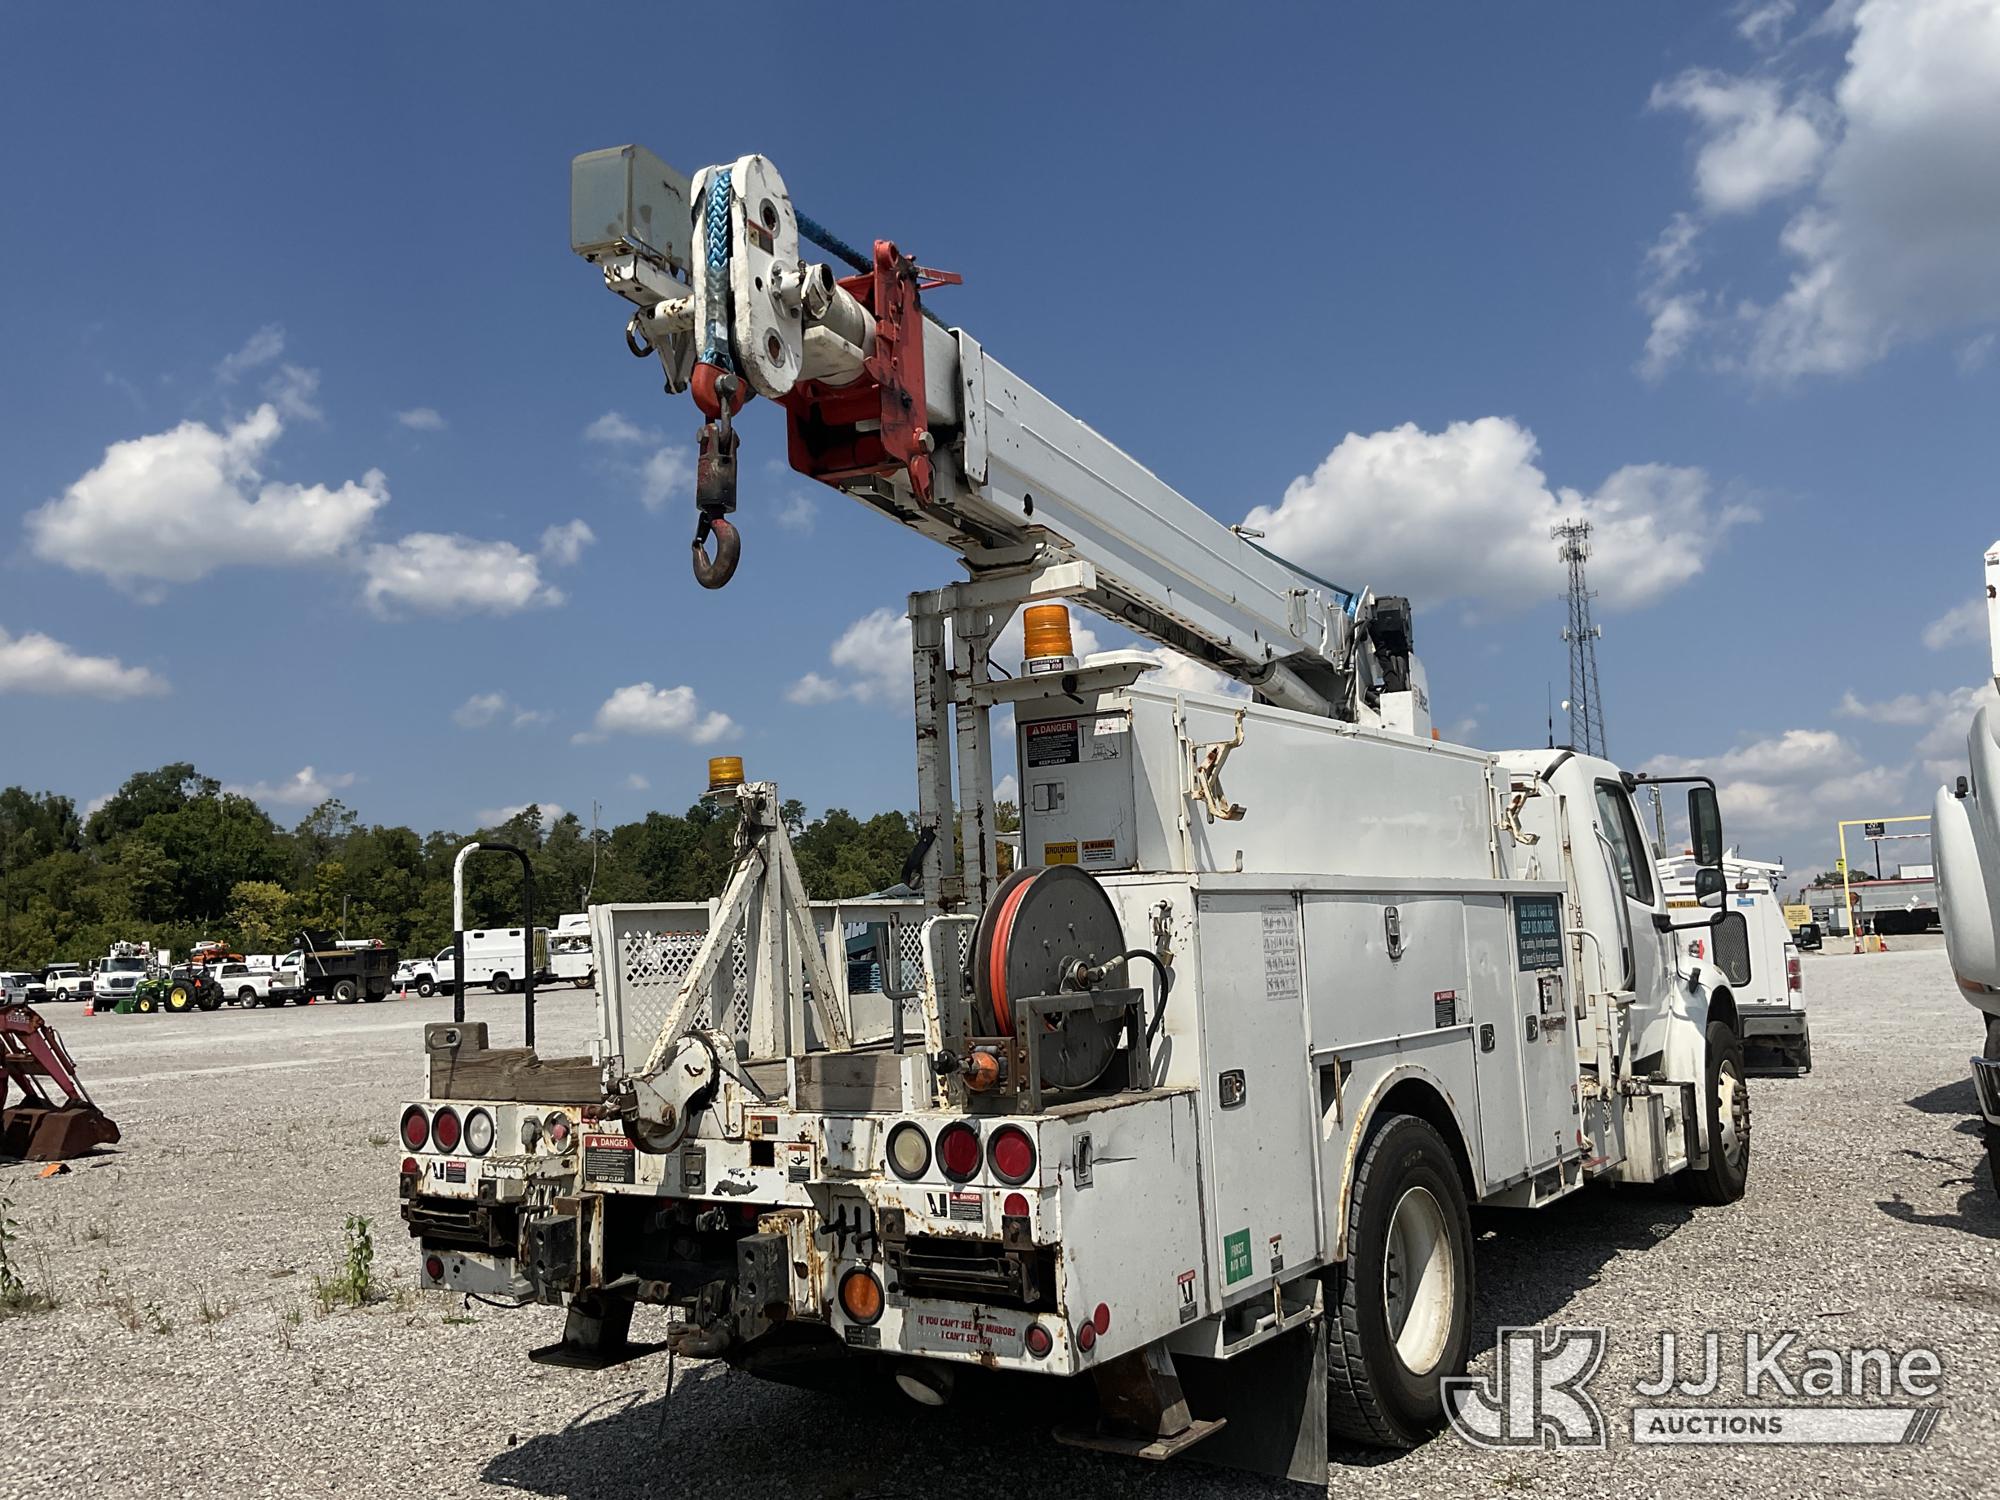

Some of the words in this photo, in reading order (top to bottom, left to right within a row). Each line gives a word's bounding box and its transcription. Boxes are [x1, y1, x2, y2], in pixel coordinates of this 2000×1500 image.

[1040, 723, 1072, 734] DANGER
[1045, 845, 1077, 855] GROUNDED
[1520, 920, 1531, 934] HELP
[600, 1138, 629, 1147] DANGER
[1231, 1241, 1244, 1257] FIRST
[1230, 1258, 1239, 1272] AID
[1239, 1254, 1248, 1267] KIT
[918, 1315, 924, 1325] IF
[925, 1316, 939, 1325] YOU
[940, 1318, 959, 1328] CAN'T
[961, 1320, 973, 1330] SEE
[985, 1324, 1016, 1336] MIRRORS
[945, 1331, 965, 1341] CAN'T
[966, 1333, 979, 1343] SEE
[979, 1336, 993, 1346] YOU
